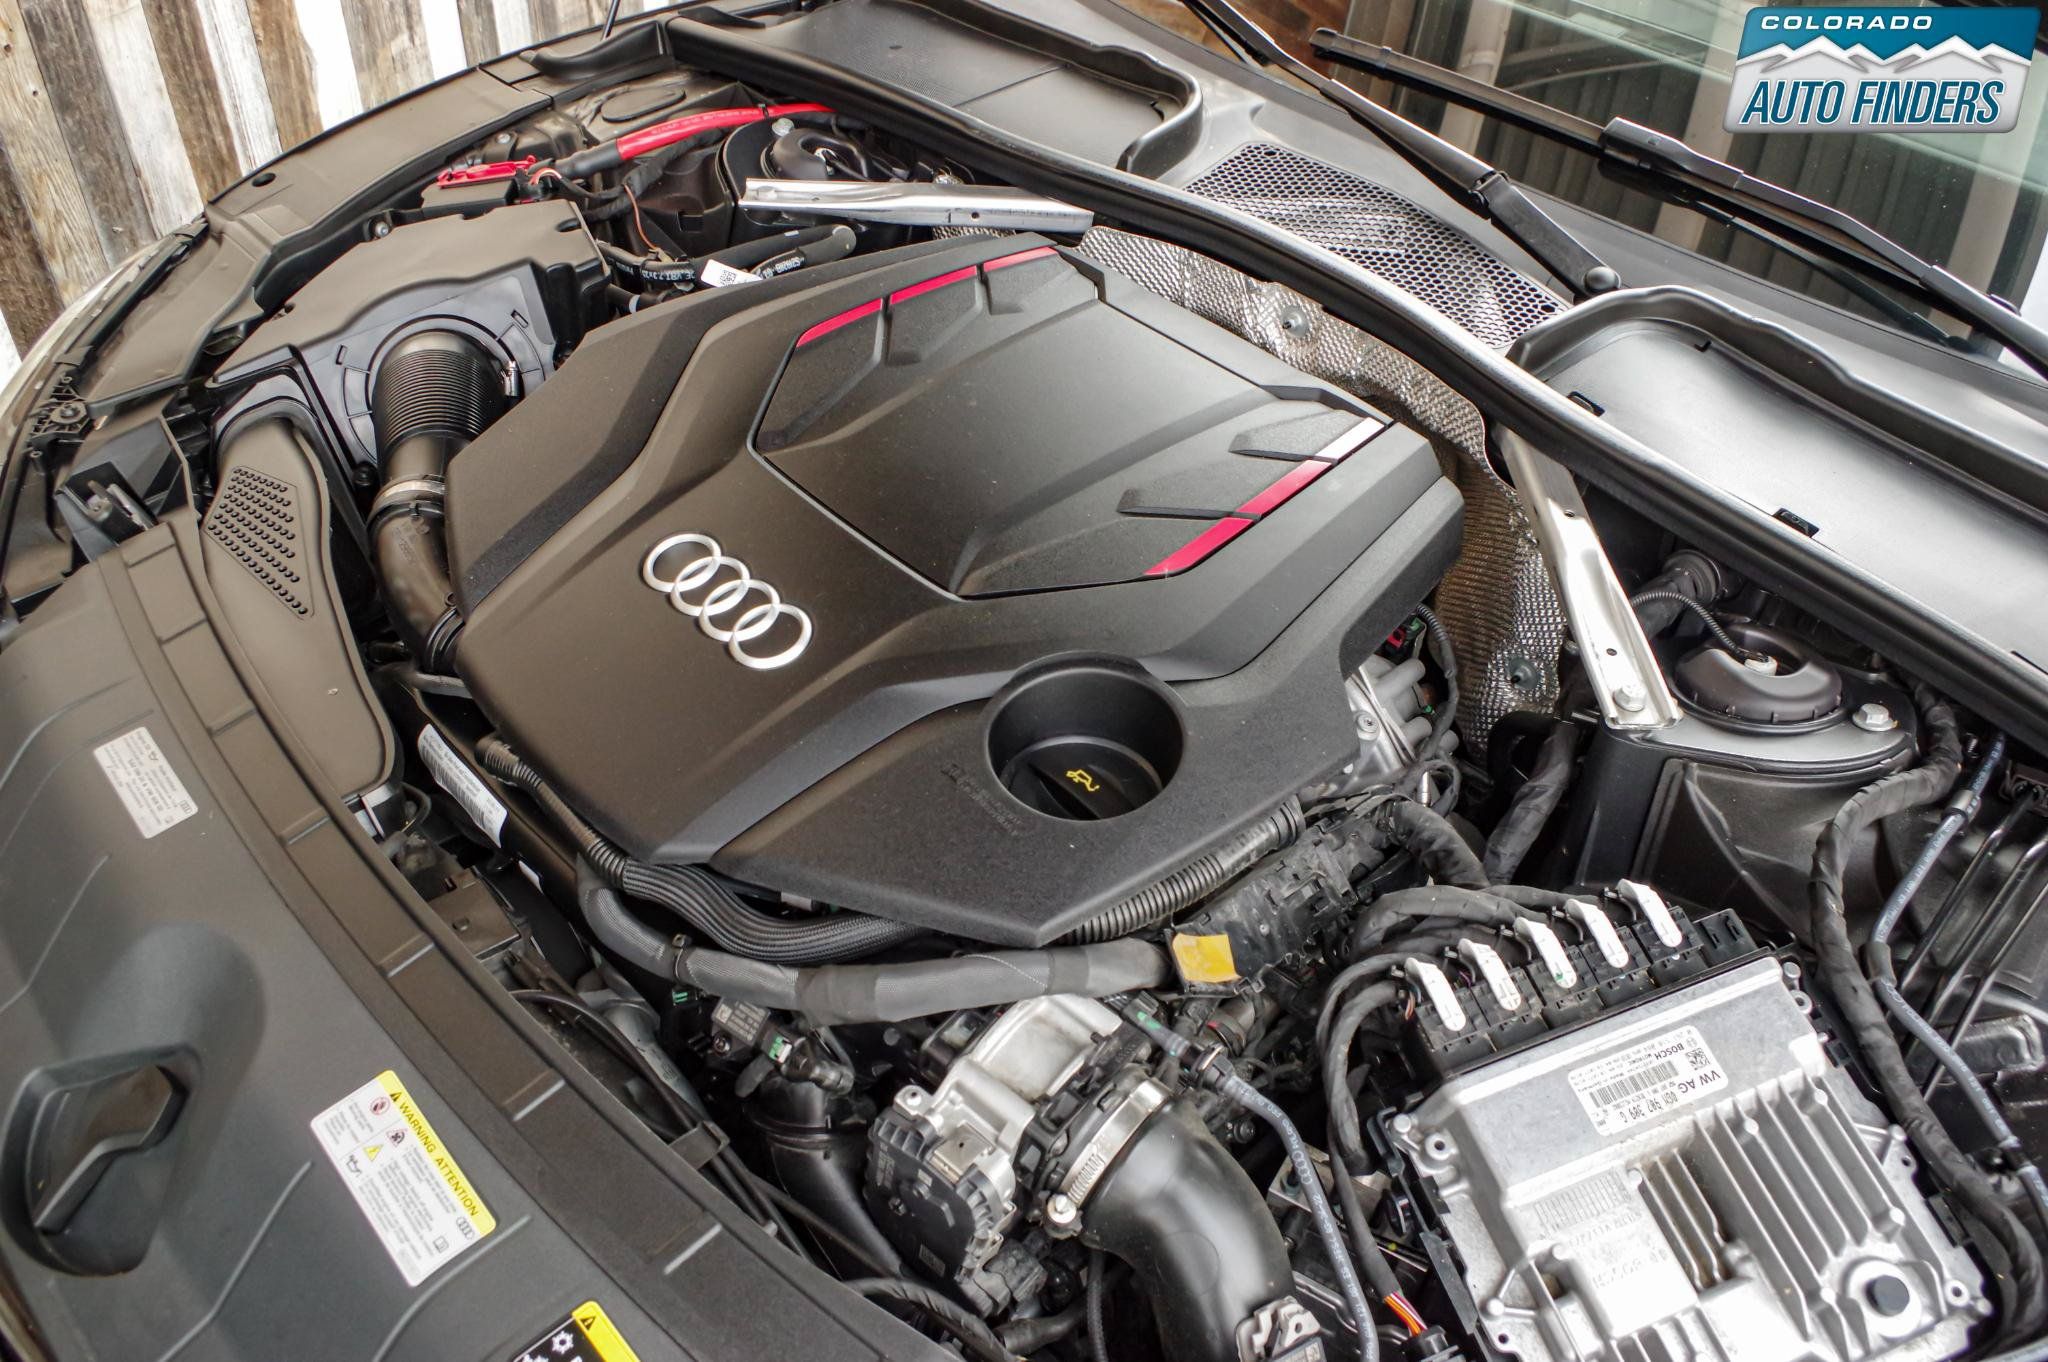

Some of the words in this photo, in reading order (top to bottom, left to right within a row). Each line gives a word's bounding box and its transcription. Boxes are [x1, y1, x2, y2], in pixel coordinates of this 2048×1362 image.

[1654, 1043, 1684, 1059] BOSCH
[1699, 1070, 1720, 1085] VW
[1678, 1078, 1696, 1093] AG
[399, 1102, 436, 1153] WARNING
[435, 1157, 478, 1217] ATTENTION
